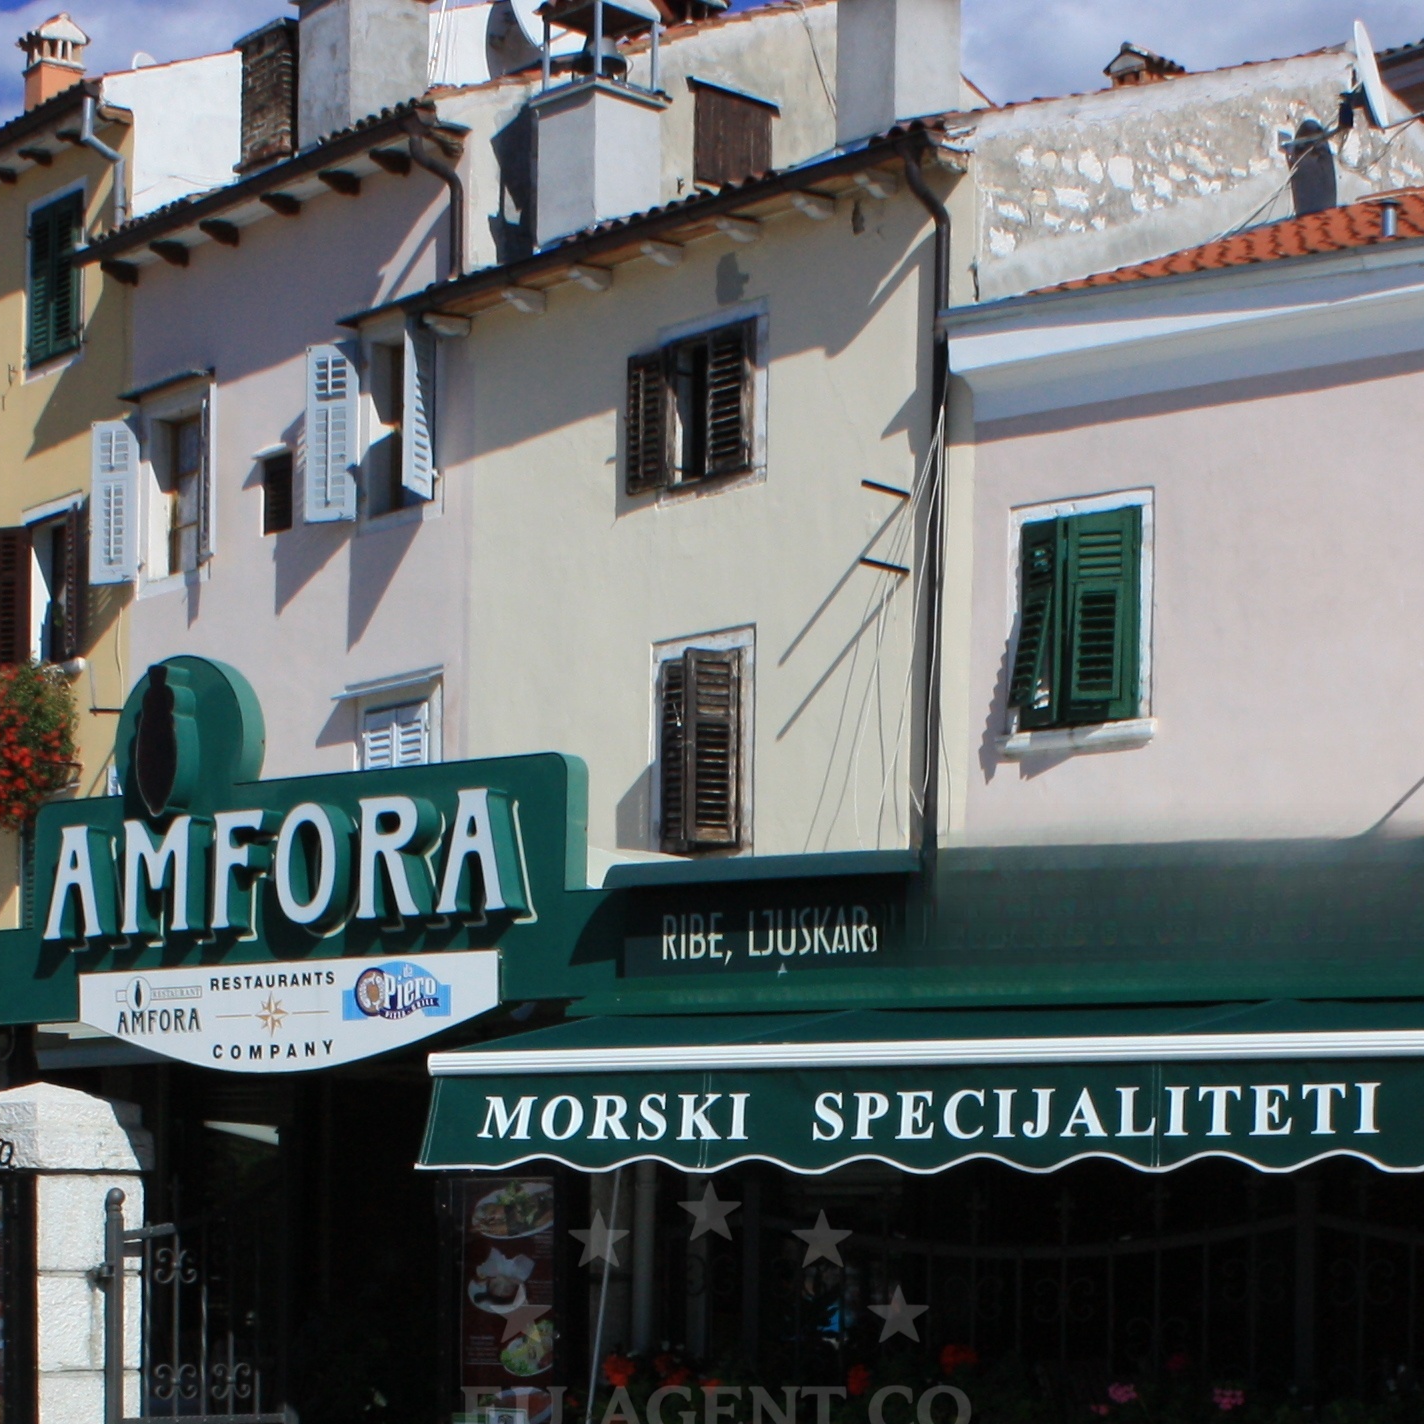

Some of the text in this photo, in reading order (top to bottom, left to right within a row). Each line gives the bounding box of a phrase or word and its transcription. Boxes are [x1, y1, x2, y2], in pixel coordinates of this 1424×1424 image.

[44, 789, 506, 941] AMFORA
[662, 912, 732, 966] RIBE,
[209, 971, 335, 992] RESTAURANTS
[384, 972, 437, 1010] Piero
[117, 1007, 202, 1034] AMFORA
[212, 1040, 334, 1061] COMPANY
[477, 1093, 751, 1141] MORSKI
[812, 1082, 1381, 1141] SPECIJALITETI
